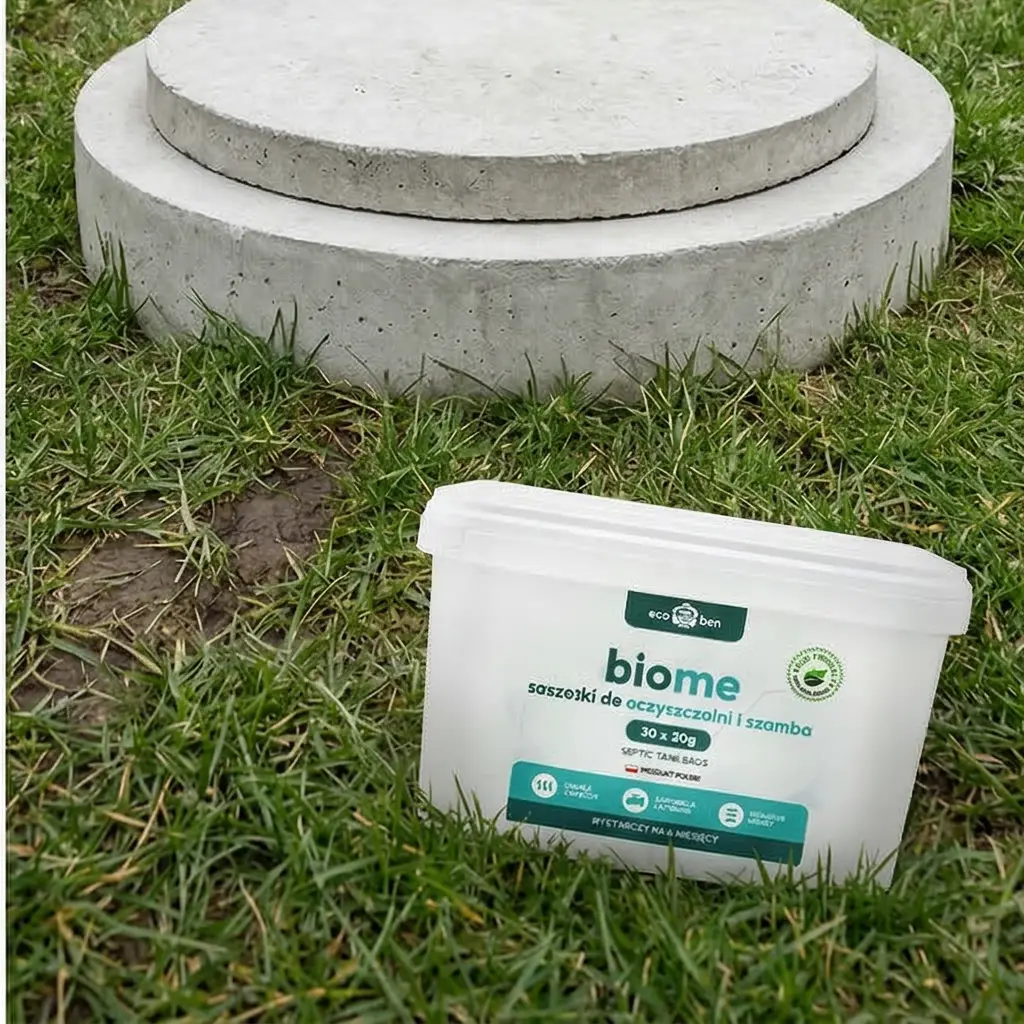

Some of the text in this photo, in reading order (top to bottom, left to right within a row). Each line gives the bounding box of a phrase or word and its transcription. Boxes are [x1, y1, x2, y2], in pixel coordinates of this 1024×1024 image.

[648, 610, 721, 628] eco ben
[605, 647, 740, 701] biome
[601, 691, 622, 707] de
[626, 699, 734, 726] oczyszczolni
[737, 710, 743, 726] i
[746, 715, 813, 737] szamba
[641, 726, 697, 748] 30 x 20g
